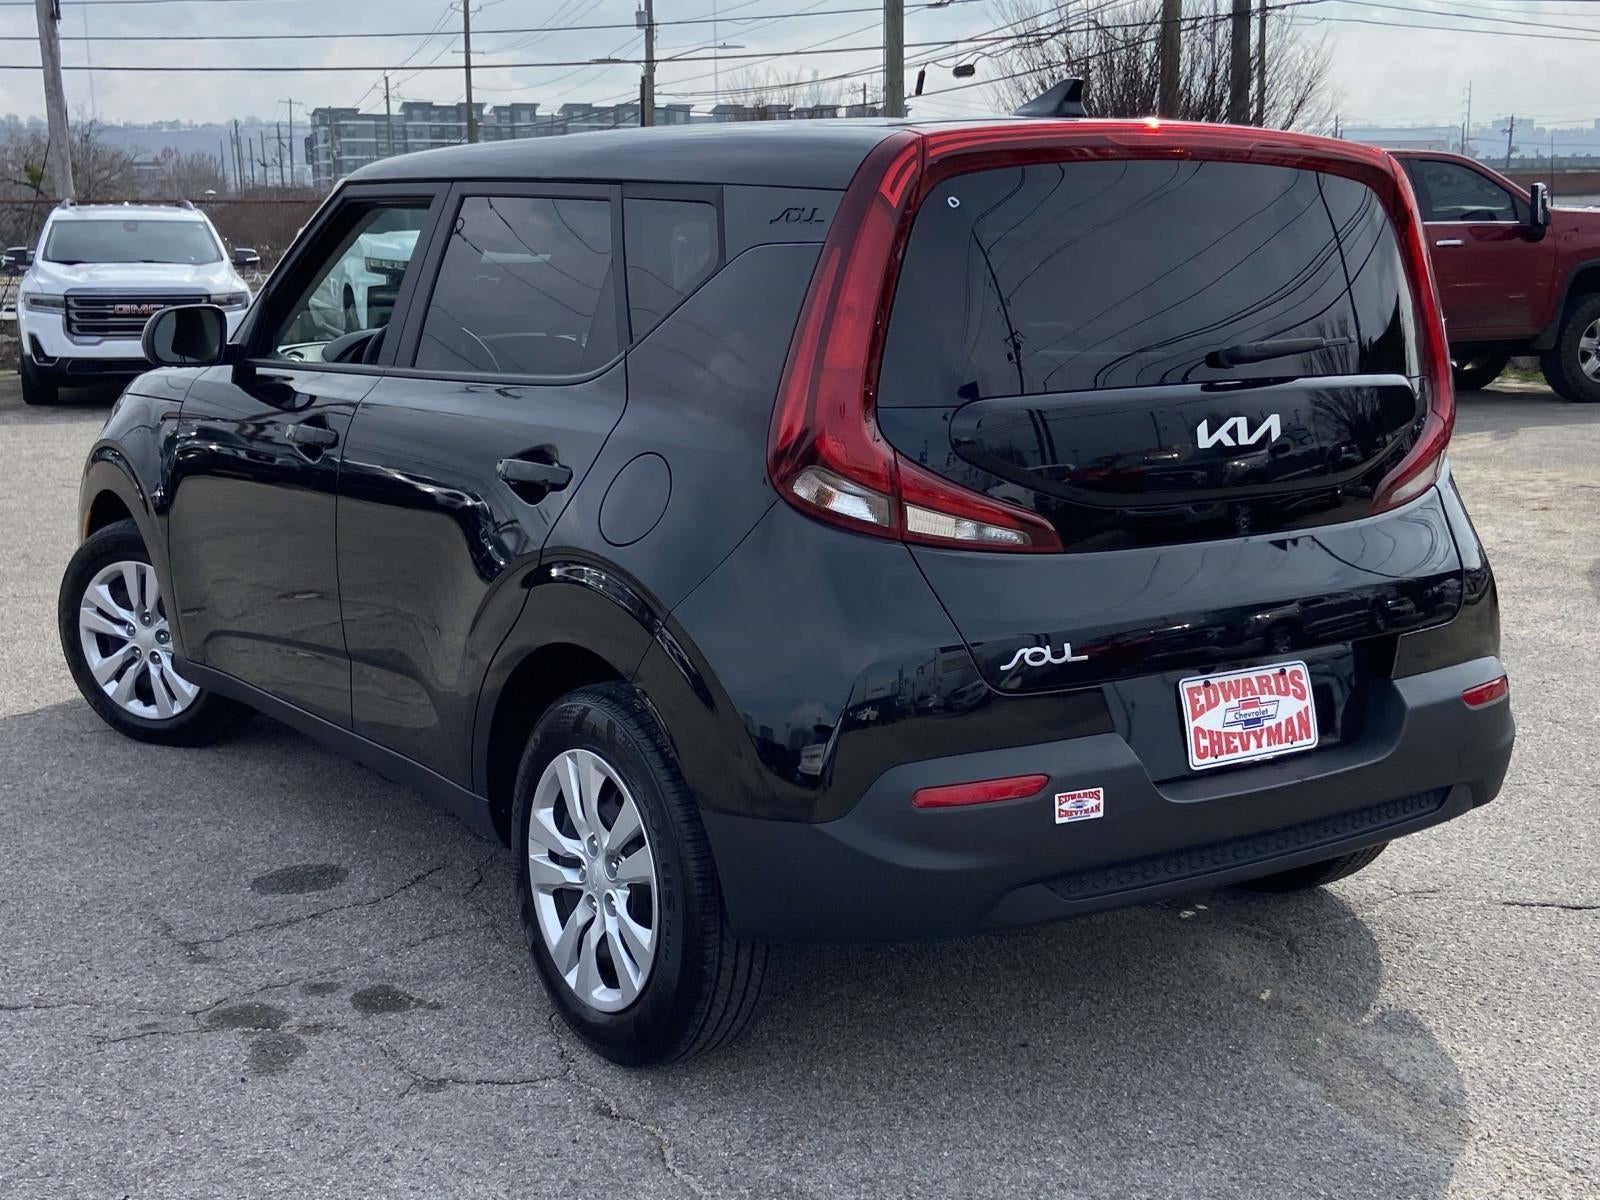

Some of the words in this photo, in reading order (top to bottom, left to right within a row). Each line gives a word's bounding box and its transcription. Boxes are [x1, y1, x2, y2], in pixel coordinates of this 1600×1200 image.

[1000, 642, 1088, 671] SOUL
[1186, 669, 1307, 722] EDWARDS
[1234, 707, 1268, 720] Chevrolet
[1193, 705, 1312, 760] CHEVYMAN
[1057, 789, 1101, 807] EDWARDS
[1057, 802, 1101, 818] CHEVYMAN
